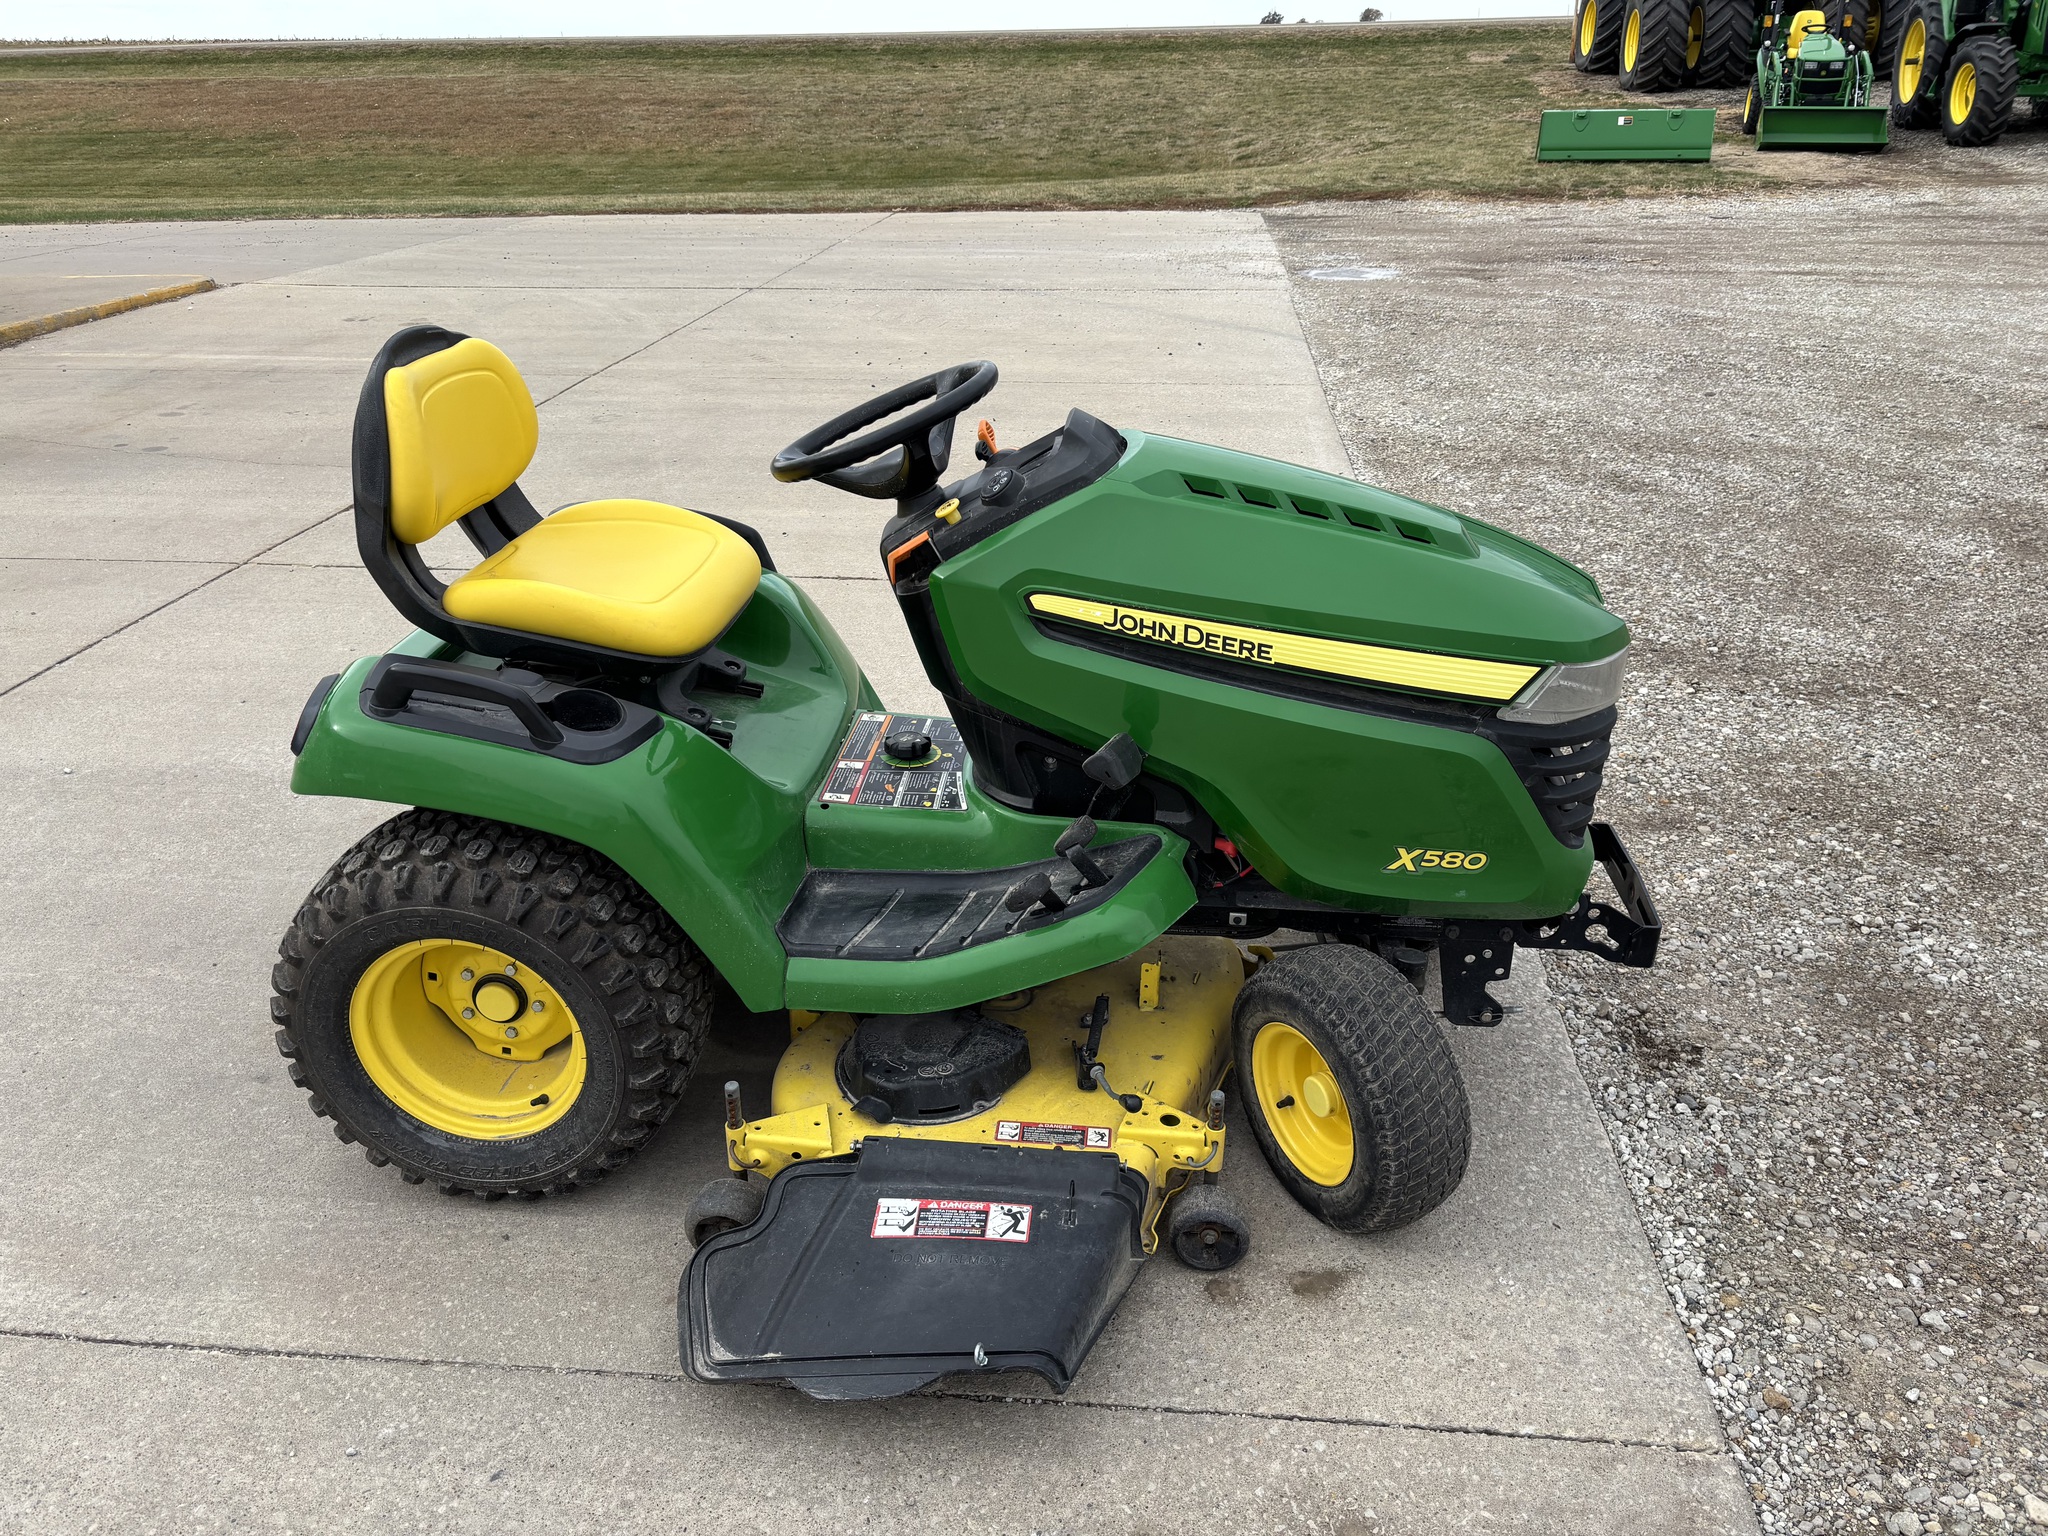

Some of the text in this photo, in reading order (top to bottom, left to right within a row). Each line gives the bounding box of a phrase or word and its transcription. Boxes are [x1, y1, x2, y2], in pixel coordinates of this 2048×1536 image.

[1104, 608, 1273, 661] JOHN DEERE
[1385, 847, 1488, 872] X580
[940, 1201, 985, 1210] DANGER
[892, 1253, 1006, 1266] DO NOT REMOVE
